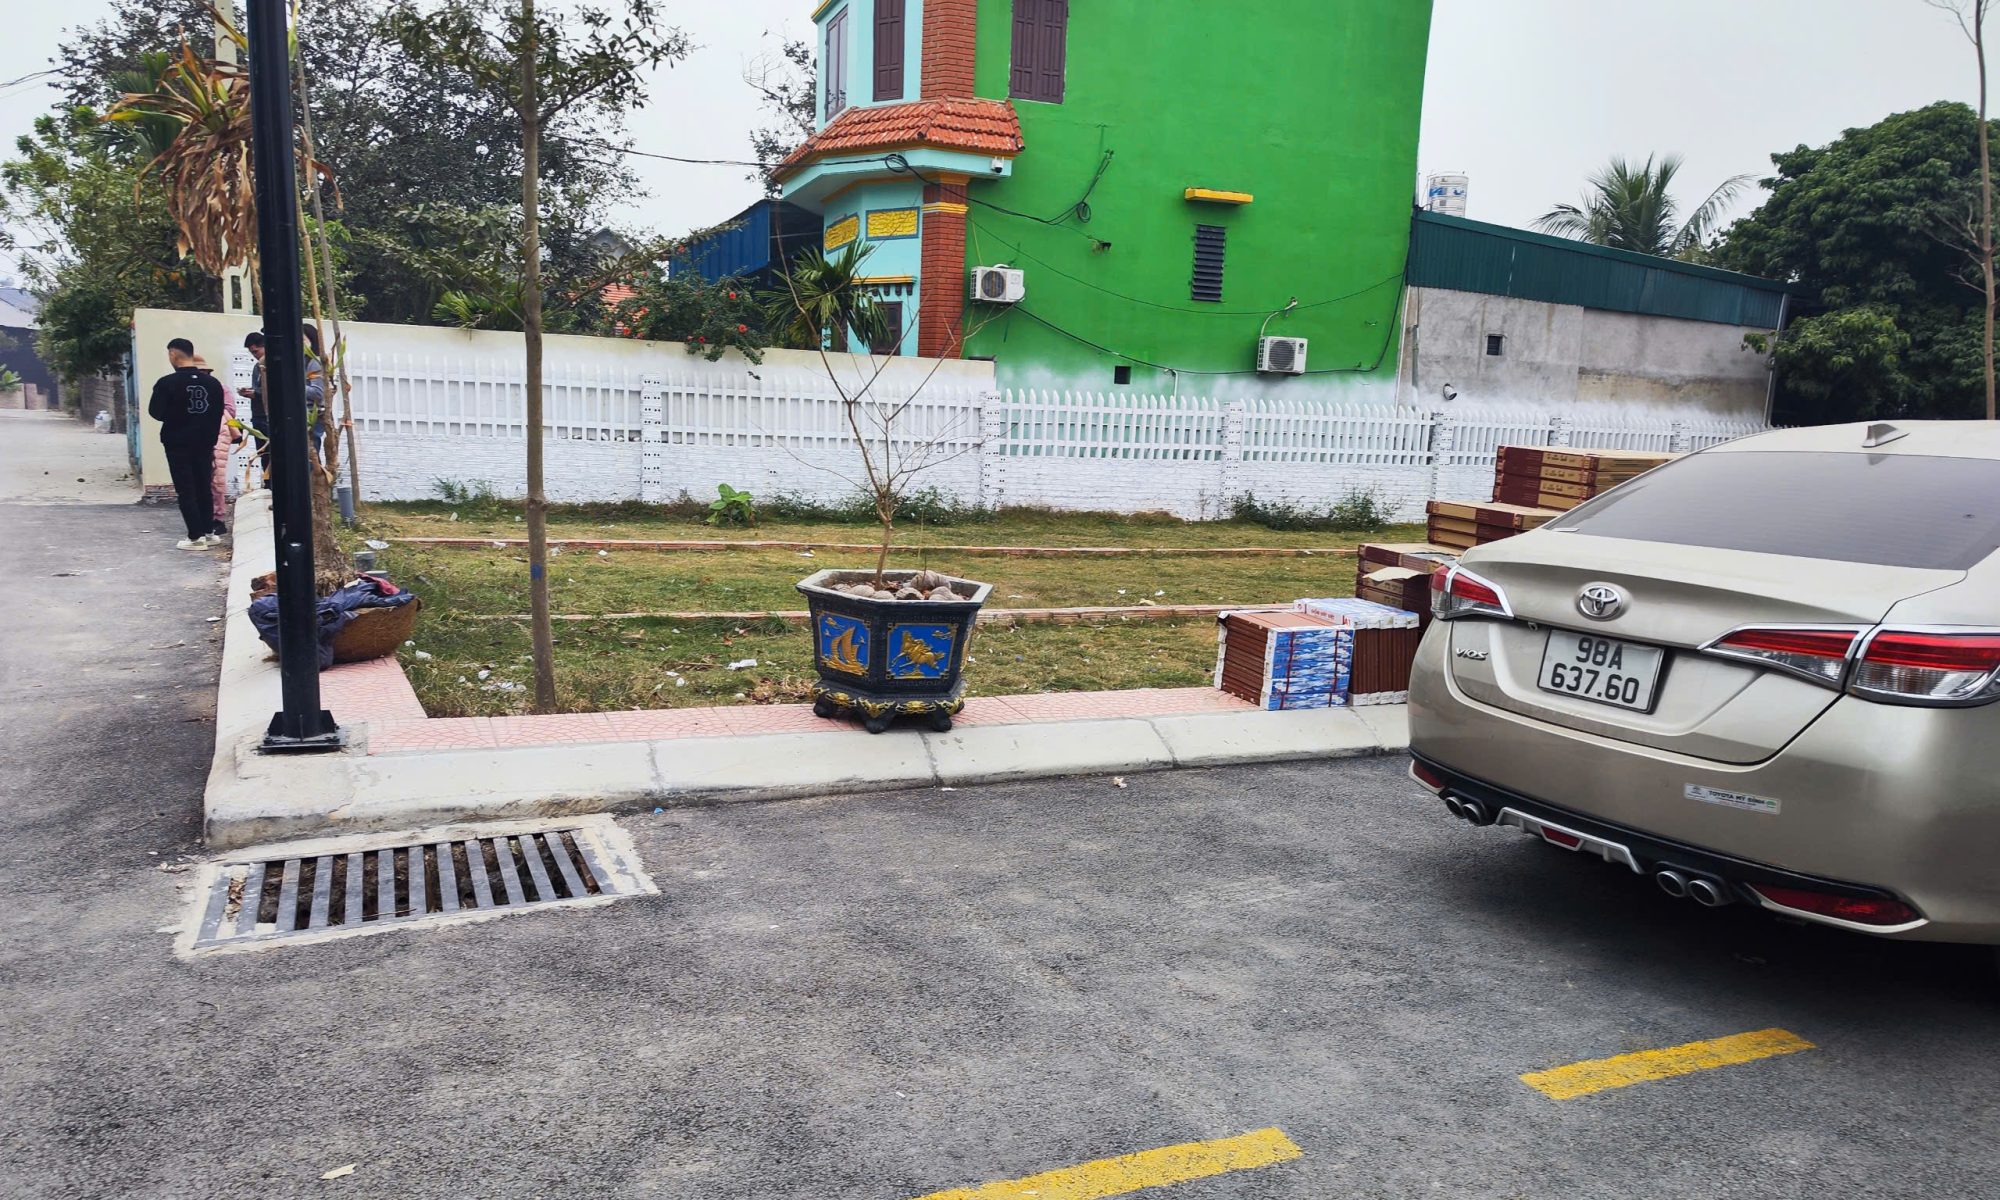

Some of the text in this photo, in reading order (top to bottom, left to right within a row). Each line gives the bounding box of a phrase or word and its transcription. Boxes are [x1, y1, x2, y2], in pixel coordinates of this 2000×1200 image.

[186, 385, 209, 413] B
[1576, 637, 1623, 670] 98A
[1551, 662, 1639, 704] 637.60
[1708, 790, 1735, 799] TOYOTA
